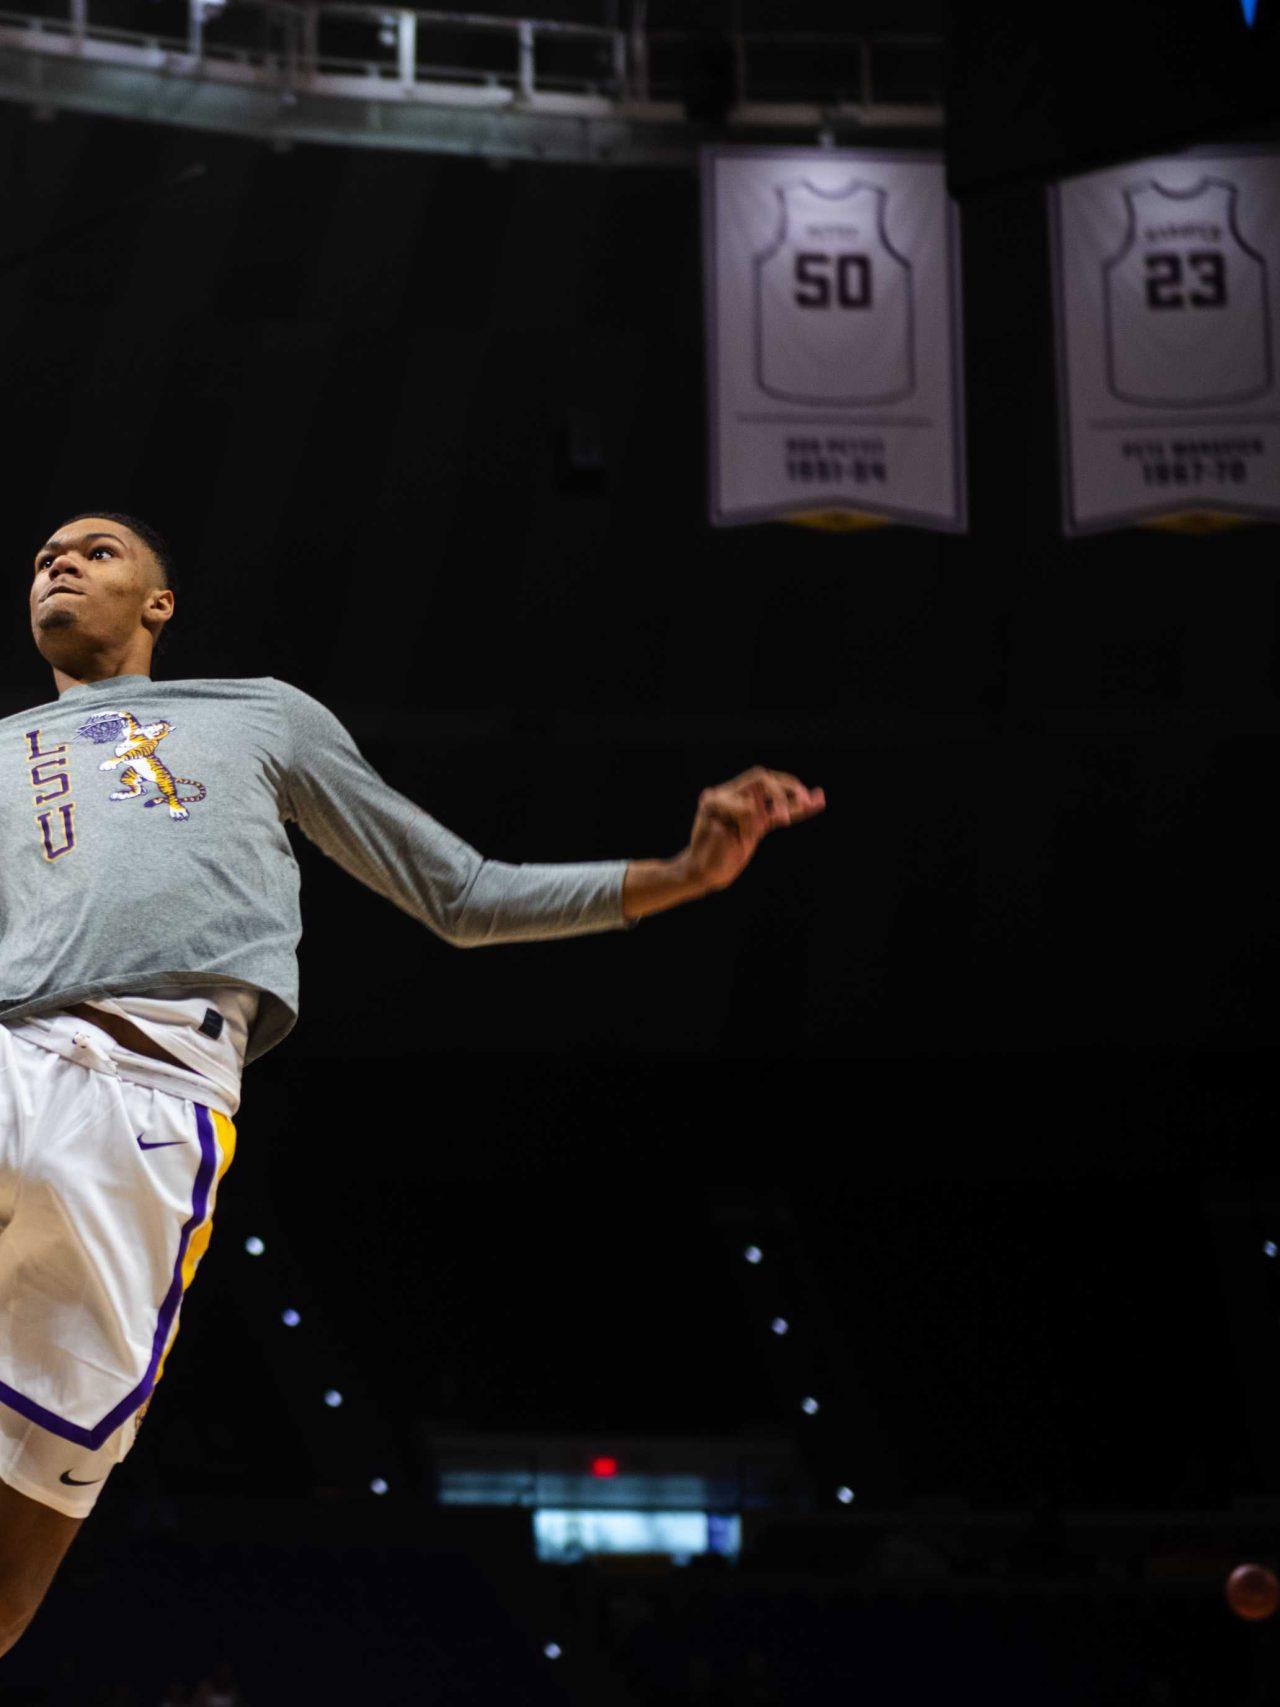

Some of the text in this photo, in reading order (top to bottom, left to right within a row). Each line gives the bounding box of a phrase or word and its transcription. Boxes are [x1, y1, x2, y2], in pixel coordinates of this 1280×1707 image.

[795, 253, 873, 309] 50
[1143, 252, 1229, 310] 23
[25, 728, 76, 863] LSU
